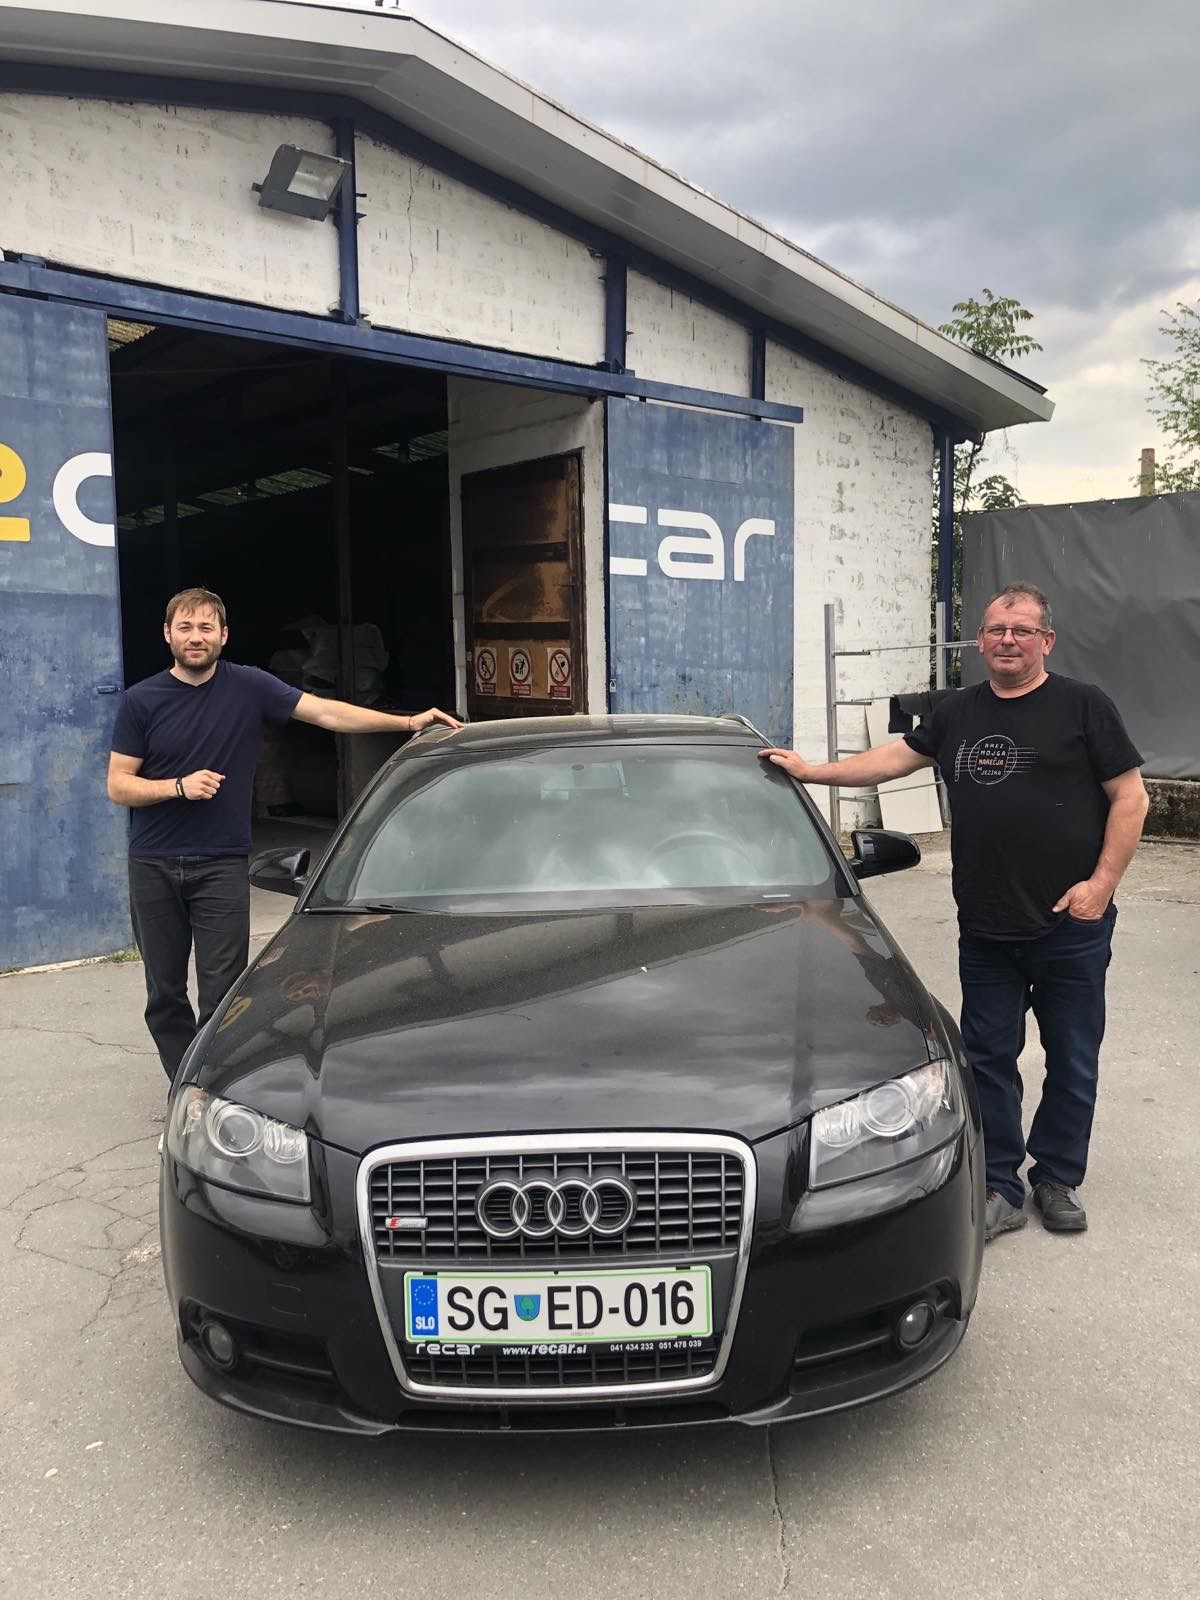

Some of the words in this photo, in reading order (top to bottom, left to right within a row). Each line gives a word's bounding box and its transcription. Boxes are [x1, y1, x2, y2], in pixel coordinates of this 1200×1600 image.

[446, 1285, 509, 1331] SG
[547, 1280, 695, 1331] ED-016
[415, 1316, 436, 1331] SLO
[416, 1343, 481, 1355] recar
[502, 1343, 587, 1355] www.recar.si
[610, 1344, 623, 1352] 041
[625, 1343, 639, 1351] 434
[640, 1343, 654, 1351] 232
[688, 1339, 702, 1348] 039
